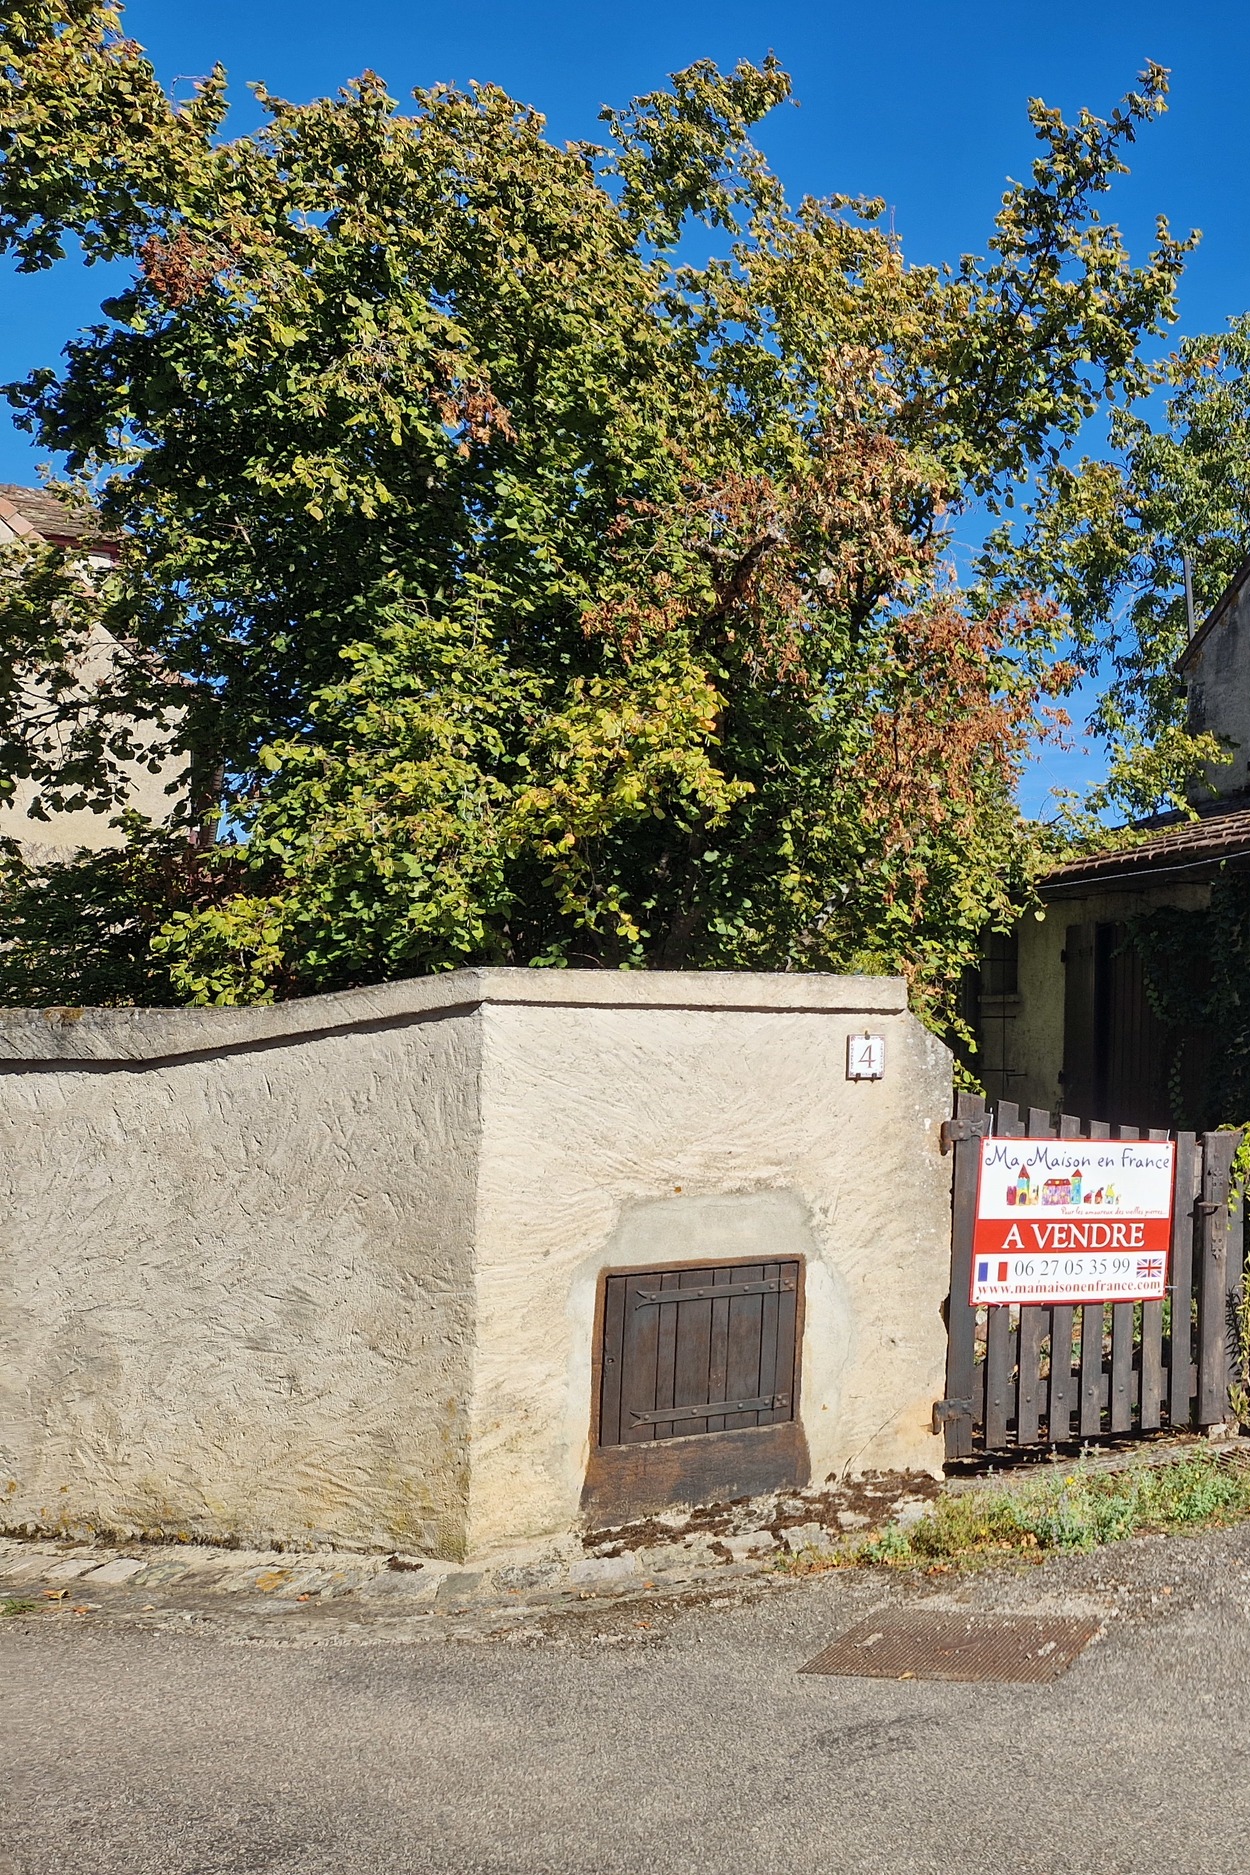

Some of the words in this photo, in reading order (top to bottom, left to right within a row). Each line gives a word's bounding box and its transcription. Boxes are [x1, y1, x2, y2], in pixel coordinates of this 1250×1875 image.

[858, 1044, 876, 1068] 4
[985, 1146, 1020, 1169] Ma
[1027, 1147, 1091, 1170] Maison
[1097, 1157, 1115, 1167] en
[1121, 1148, 1170, 1169] France
[1001, 1223, 1025, 1249] A
[1031, 1223, 1145, 1249] VENDRE
[1014, 1259, 1034, 1277] 06
[1040, 1259, 1059, 1276] 27
[1064, 1258, 1083, 1275] 05
[1089, 1258, 1107, 1275] 35
[1112, 1257, 1131, 1274] 99
[977, 1279, 1161, 1296] www.mamaisonenfrance.com
